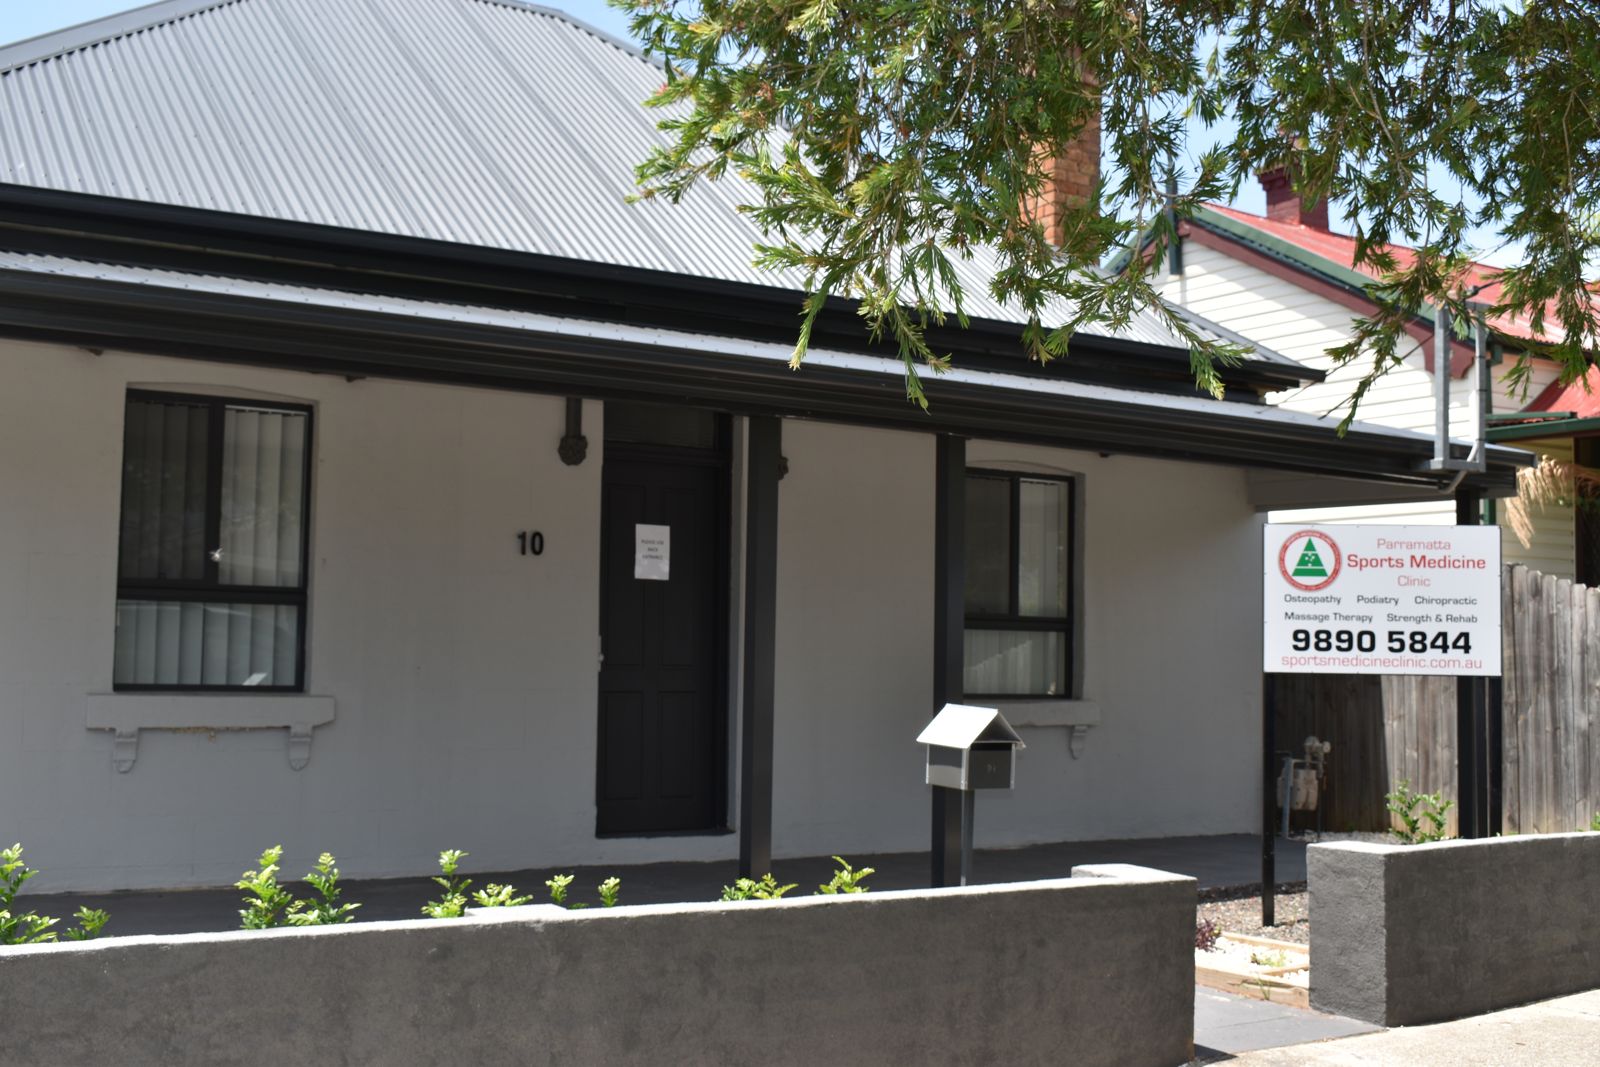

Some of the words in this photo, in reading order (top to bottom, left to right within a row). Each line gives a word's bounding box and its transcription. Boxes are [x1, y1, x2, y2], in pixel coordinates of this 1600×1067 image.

[517, 531, 544, 556] 10
[1377, 538, 1451, 550] Parramatta
[1347, 554, 1404, 571] Sports
[1410, 555, 1486, 569] Medicine
[1397, 575, 1431, 587] Clinic
[1284, 594, 1341, 605] Osteopathy
[1357, 595, 1399, 605] Podiatry
[1414, 596, 1477, 605] Chiropractic
[1285, 612, 1330, 623] Massage
[1333, 613, 1373, 623] Therapy
[1387, 613, 1432, 624] Strength
[1435, 614, 1442, 622] &
[1446, 614, 1478, 623] Rehab
[1292, 629, 1376, 652] 9890
[1387, 631, 1471, 654] 5844
[1281, 655, 1482, 669] sportsmedicineclinic.com.au
